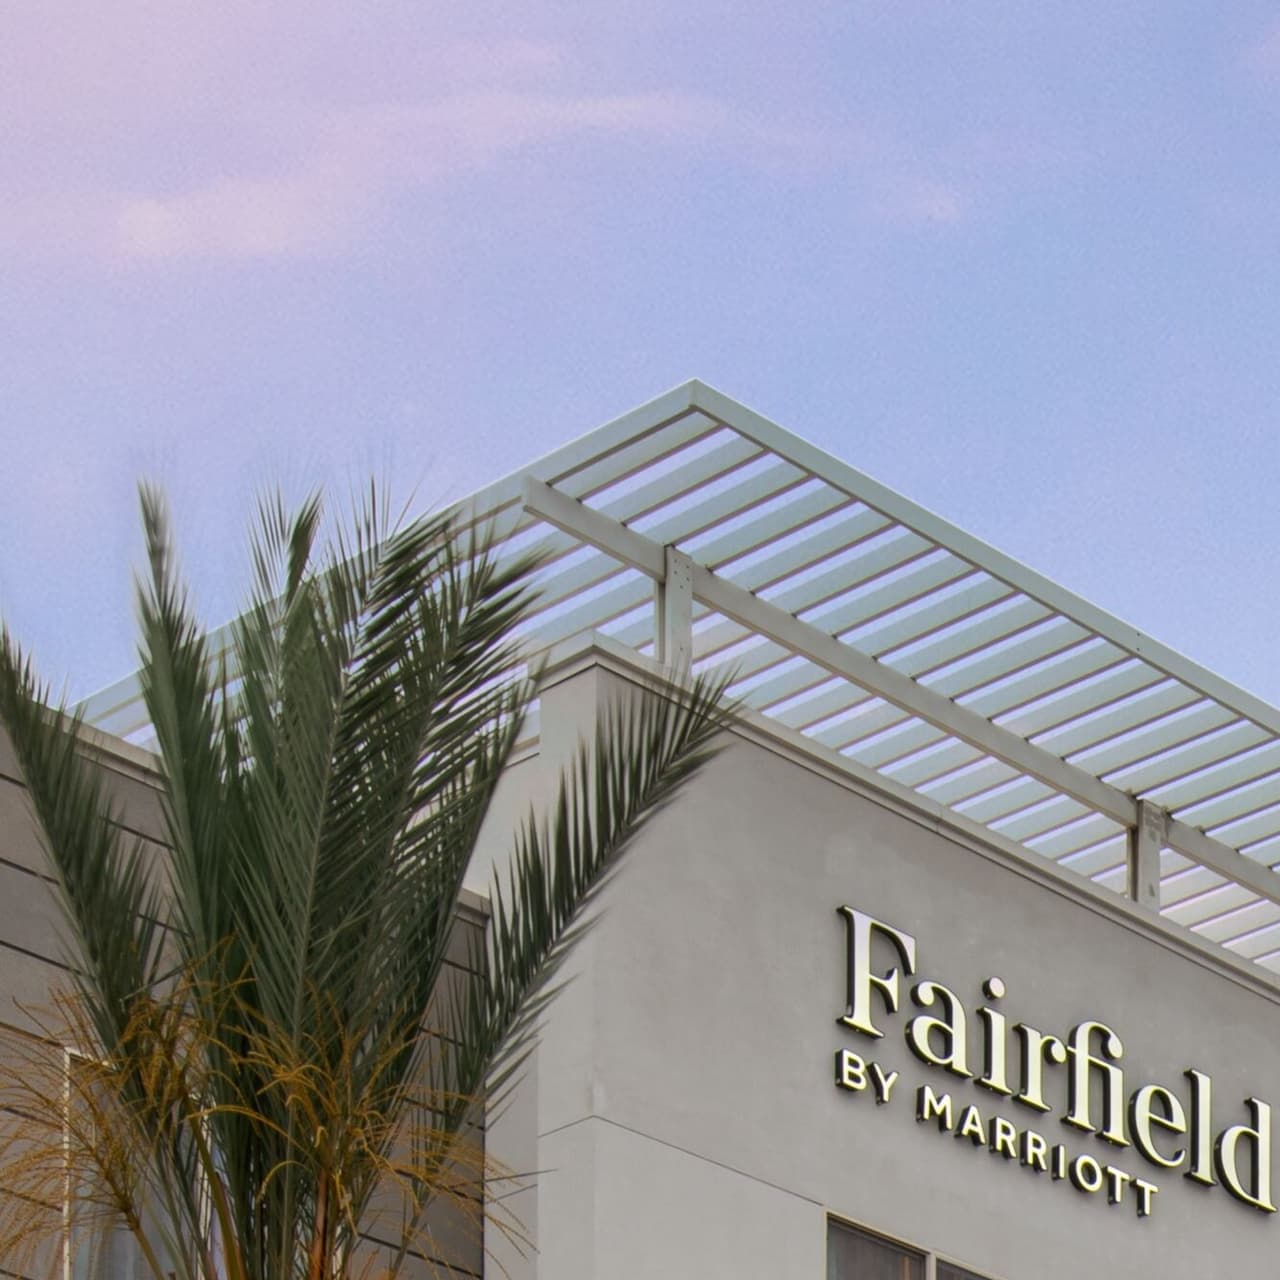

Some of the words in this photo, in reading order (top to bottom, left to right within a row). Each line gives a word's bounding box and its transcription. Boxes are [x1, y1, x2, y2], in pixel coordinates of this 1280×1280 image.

[835, 1048, 898, 1105] BY
[916, 1084, 1158, 1217] MARRIOTT
[837, 904, 1277, 1213] Fairfield
